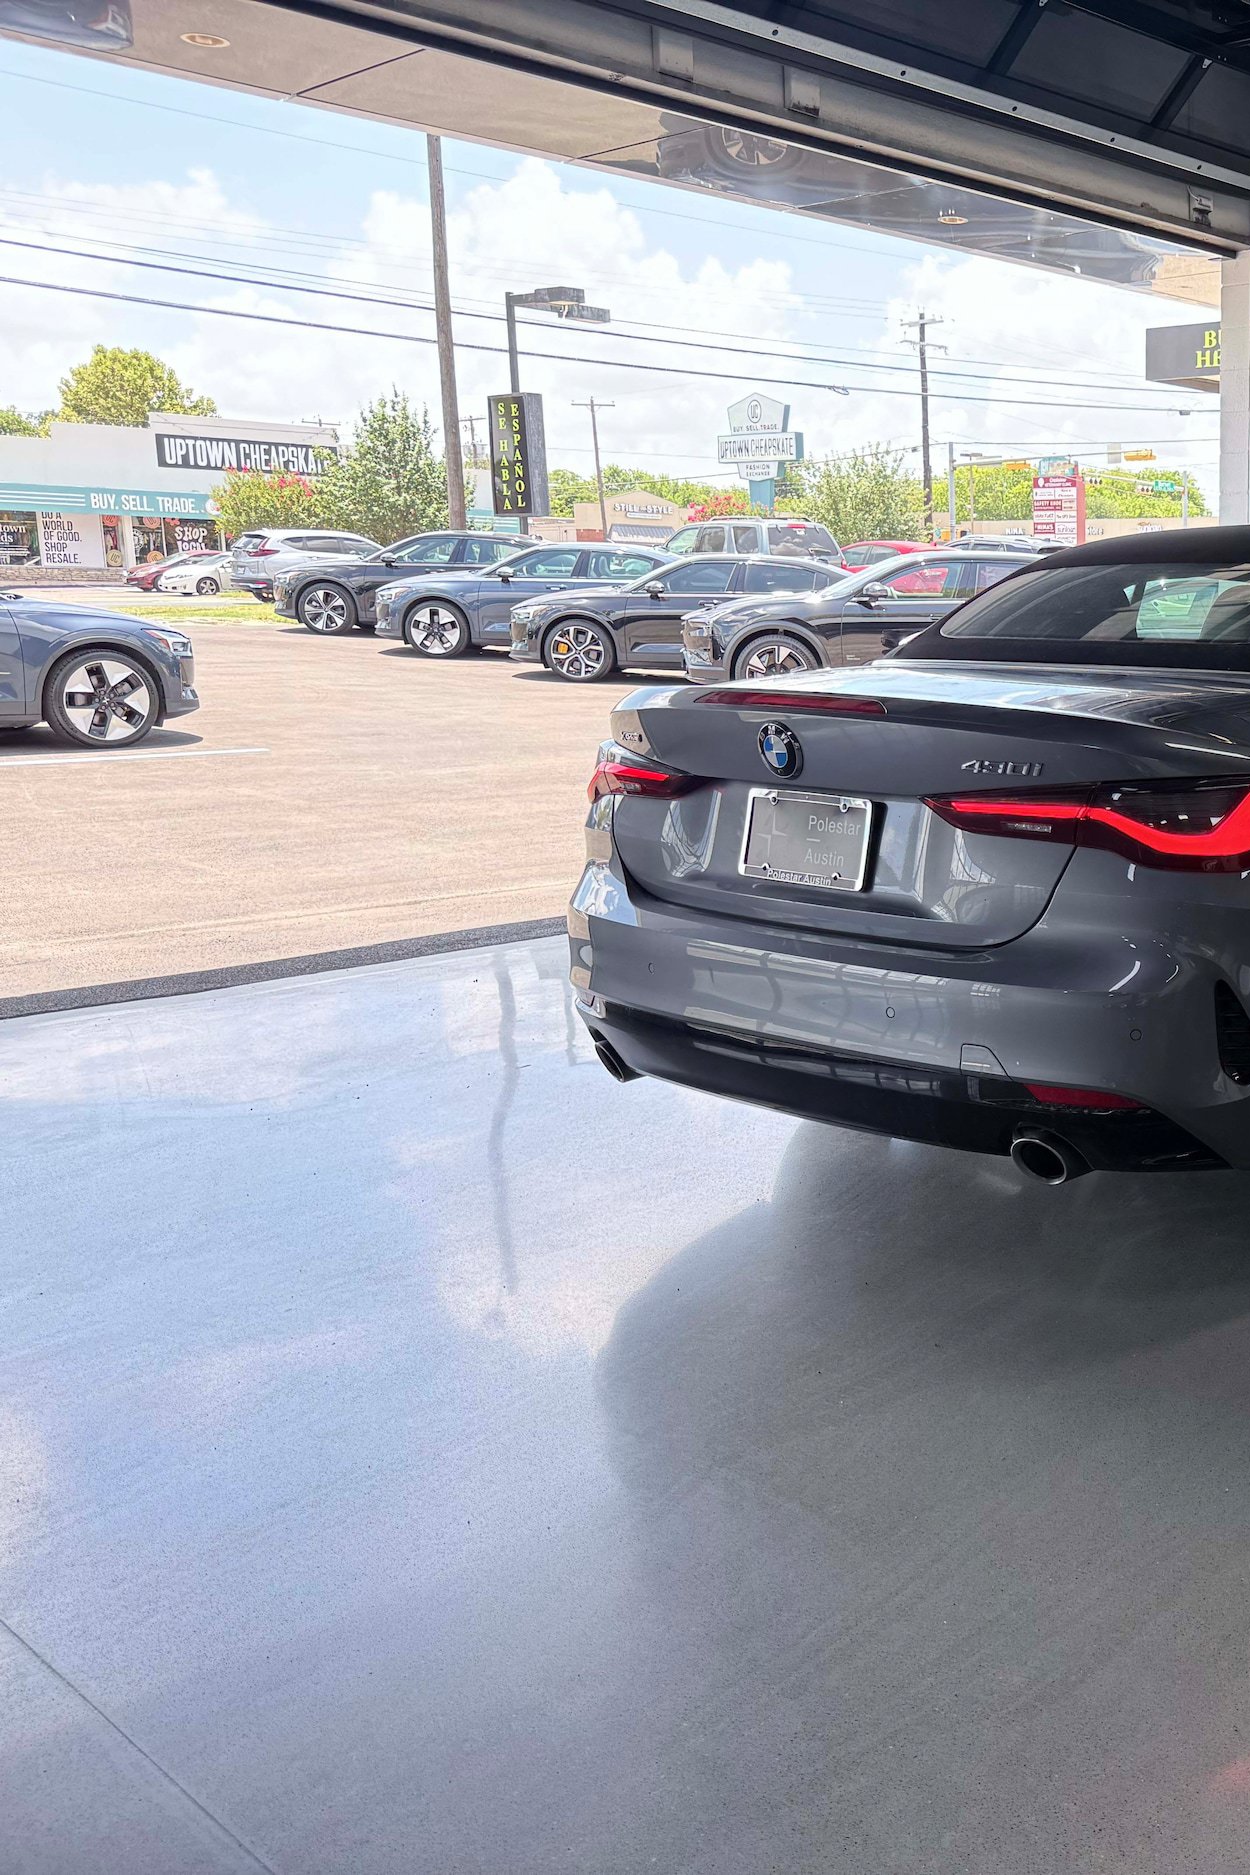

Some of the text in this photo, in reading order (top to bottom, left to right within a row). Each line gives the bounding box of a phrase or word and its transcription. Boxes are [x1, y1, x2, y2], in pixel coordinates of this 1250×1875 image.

[1203, 330, 1221, 348] B
[164, 437, 237, 468] UPTOWN
[498, 403, 512, 510] SE HABLA
[511, 404, 526, 507] ESPAÑOL
[720, 437, 794, 458] UPTOWN CHEAPSKATE
[90, 493, 119, 510] BUY.
[121, 494, 154, 512] SELL.
[646, 505, 673, 514] STYLE
[42, 520, 73, 531] WORLD
[174, 526, 207, 542] SHOP
[44, 530, 82, 542] OF GOOD.
[44, 541, 67, 552] SHOP
[45, 553, 82, 564] RESALE.
[808, 815, 861, 836] Polestar
[803, 848, 845, 867] Austin
[766, 868, 832, 887] Polestar Austin
